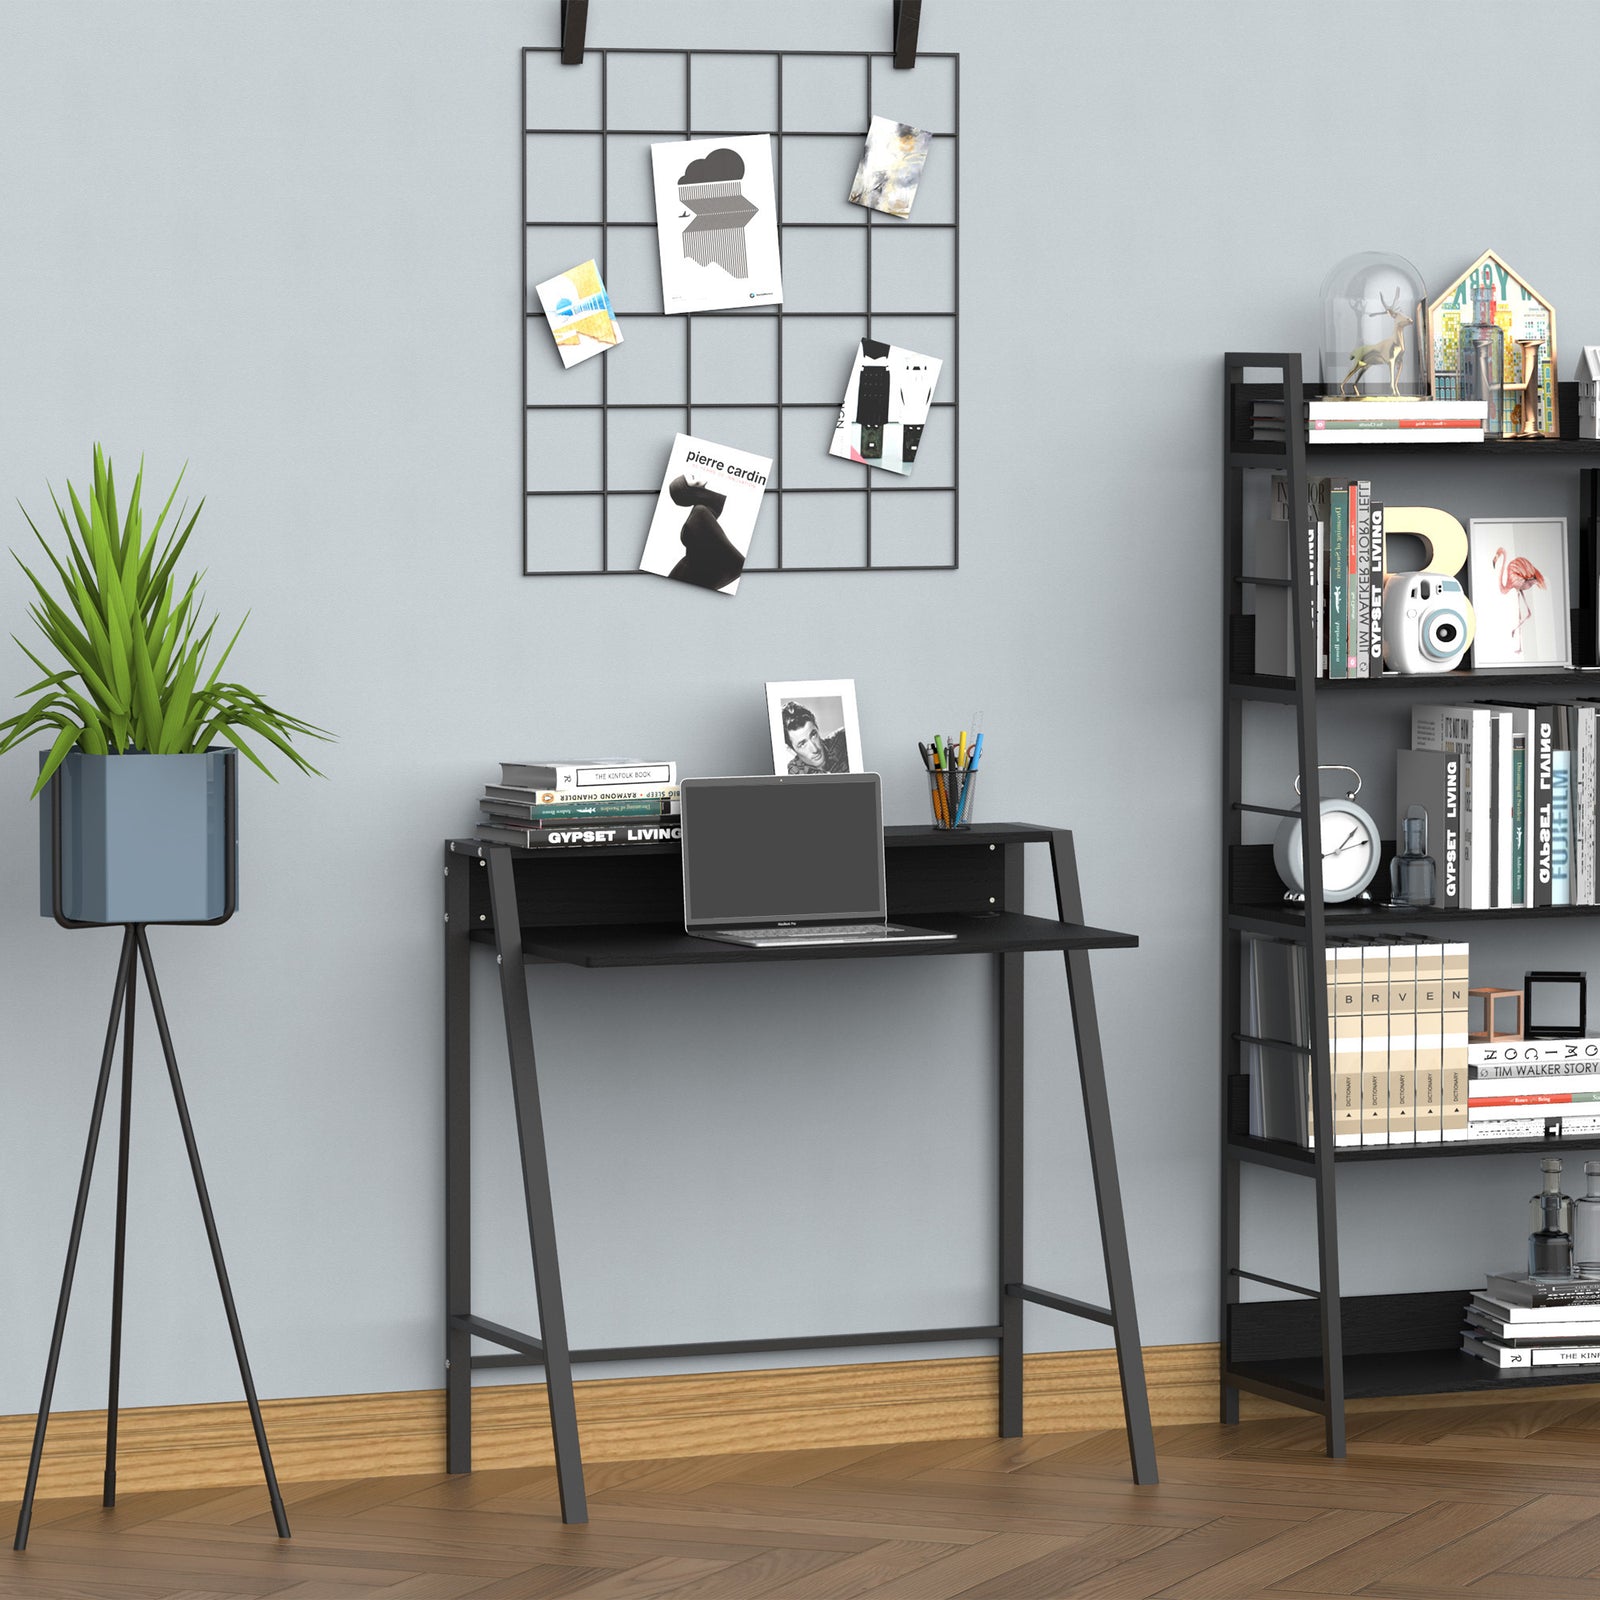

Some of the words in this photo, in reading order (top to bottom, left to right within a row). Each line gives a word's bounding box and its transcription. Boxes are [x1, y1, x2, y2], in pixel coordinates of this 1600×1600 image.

[685, 451, 725, 471] pierre
[726, 464, 767, 486] cardin
[1371, 510, 1382, 572] LIVING
[1371, 584, 1382, 658] GYPSET
[1446, 761, 1457, 818] LIVING
[548, 830, 616, 844] GYPSET
[627, 828, 682, 841] LIVING
[1446, 829, 1457, 897] GYPSET
[1345, 995, 1353, 1004] B
[1371, 994, 1380, 1003] R
[1398, 993, 1407, 1001] V
[1426, 992, 1434, 1000] E
[1452, 991, 1461, 1000] N
[1494, 1066, 1512, 1077] TIM
[1516, 1063, 1560, 1076] WALKER
[1564, 1062, 1599, 1074] STORY
